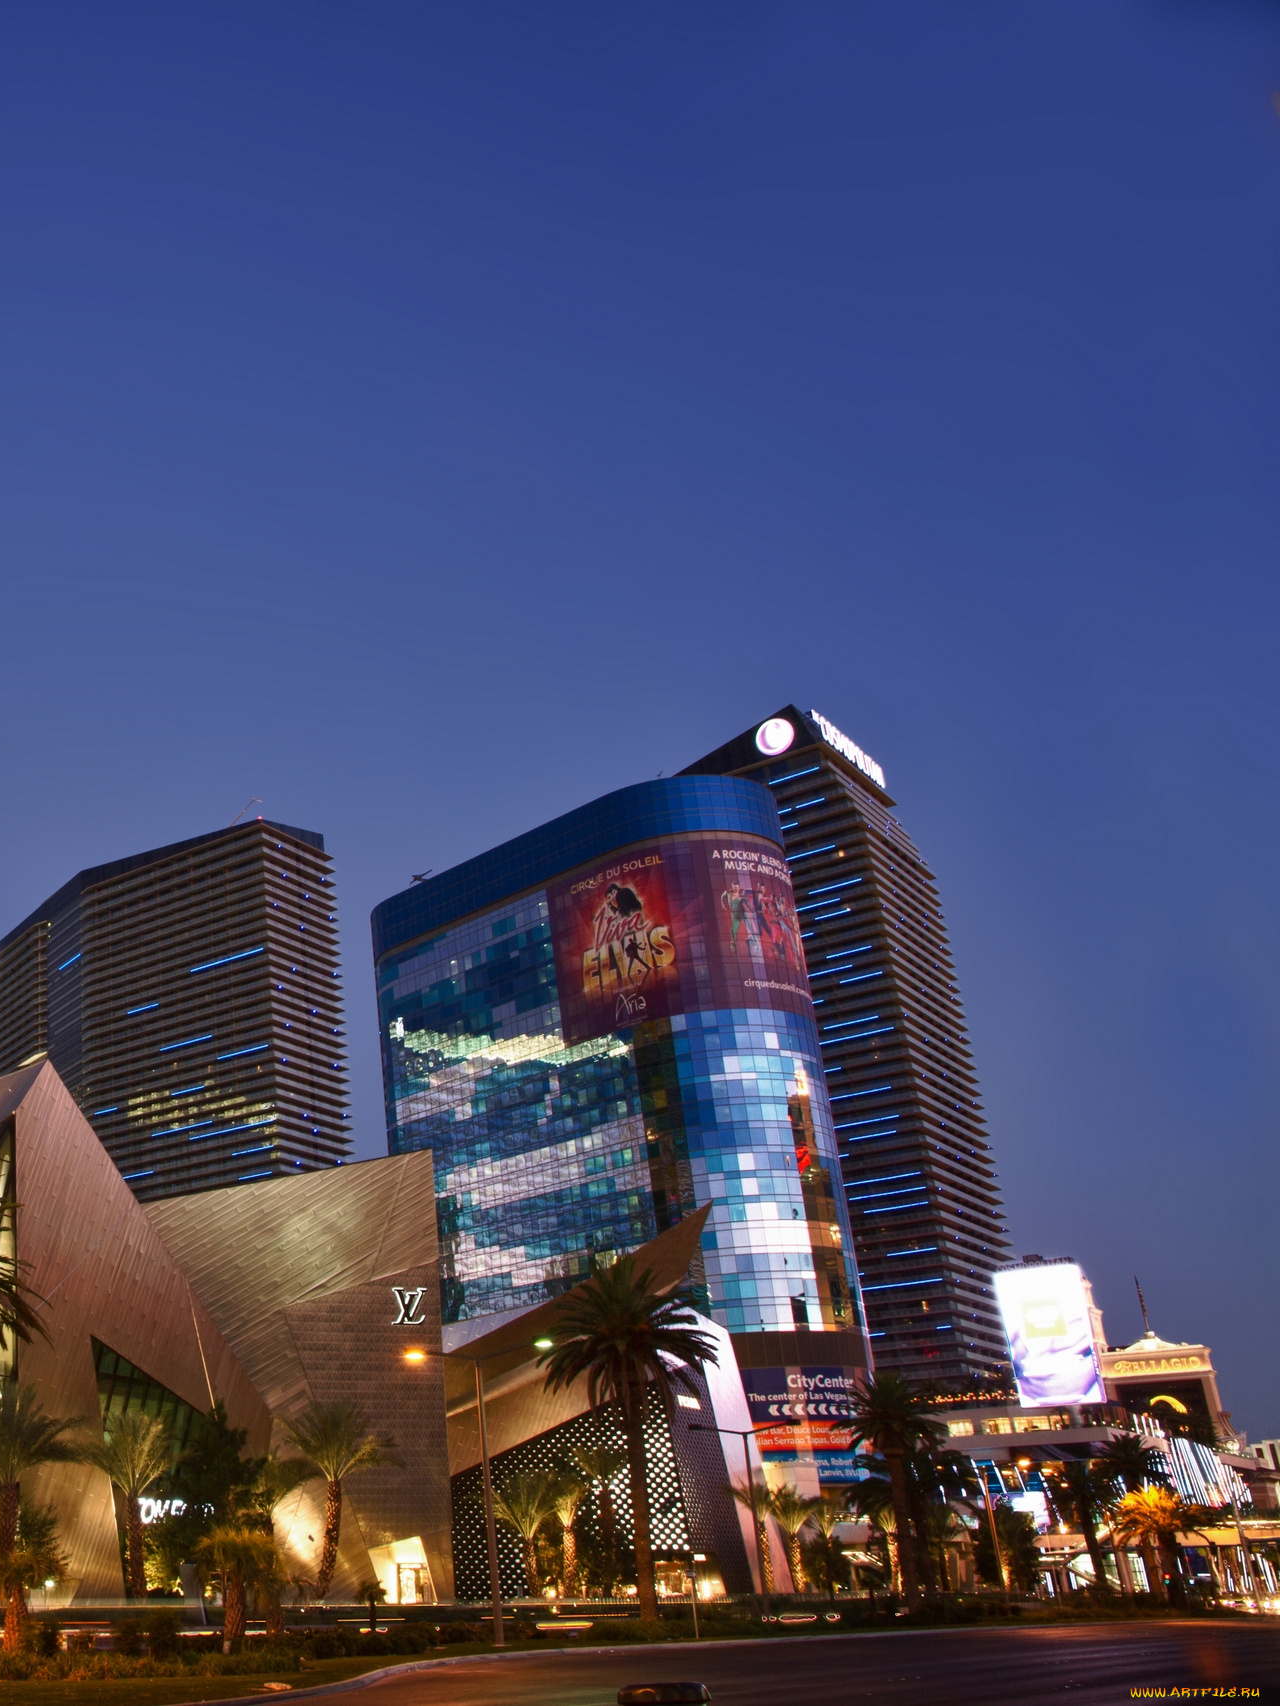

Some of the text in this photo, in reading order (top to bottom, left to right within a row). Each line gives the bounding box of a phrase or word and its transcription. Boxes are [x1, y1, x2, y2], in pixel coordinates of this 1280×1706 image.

[712, 849, 720, 859] A
[722, 849, 760, 862] ROCKIN'
[761, 854, 782, 869] BLEND
[724, 860, 756, 872] MUSIC
[757, 864, 773, 876] AND
[570, 854, 663, 895] CIRQUE DU SOLEIL
[594, 905, 650, 952] Viva
[582, 925, 677, 992] ELVIS
[616, 993, 646, 1021] Aria
[391, 1287, 427, 1325] LV
[1114, 1356, 1201, 1375] BELLAGIO
[786, 1374, 854, 1390] CityCenter
[748, 1393, 766, 1402] The
[767, 1392, 797, 1401] center
[798, 1391, 808, 1401] of
[809, 1391, 823, 1400] Las
[774, 1436, 805, 1445] Serrano
[830, 1435, 845, 1444] Gold
[786, 1426, 810, 1435] Deuce
